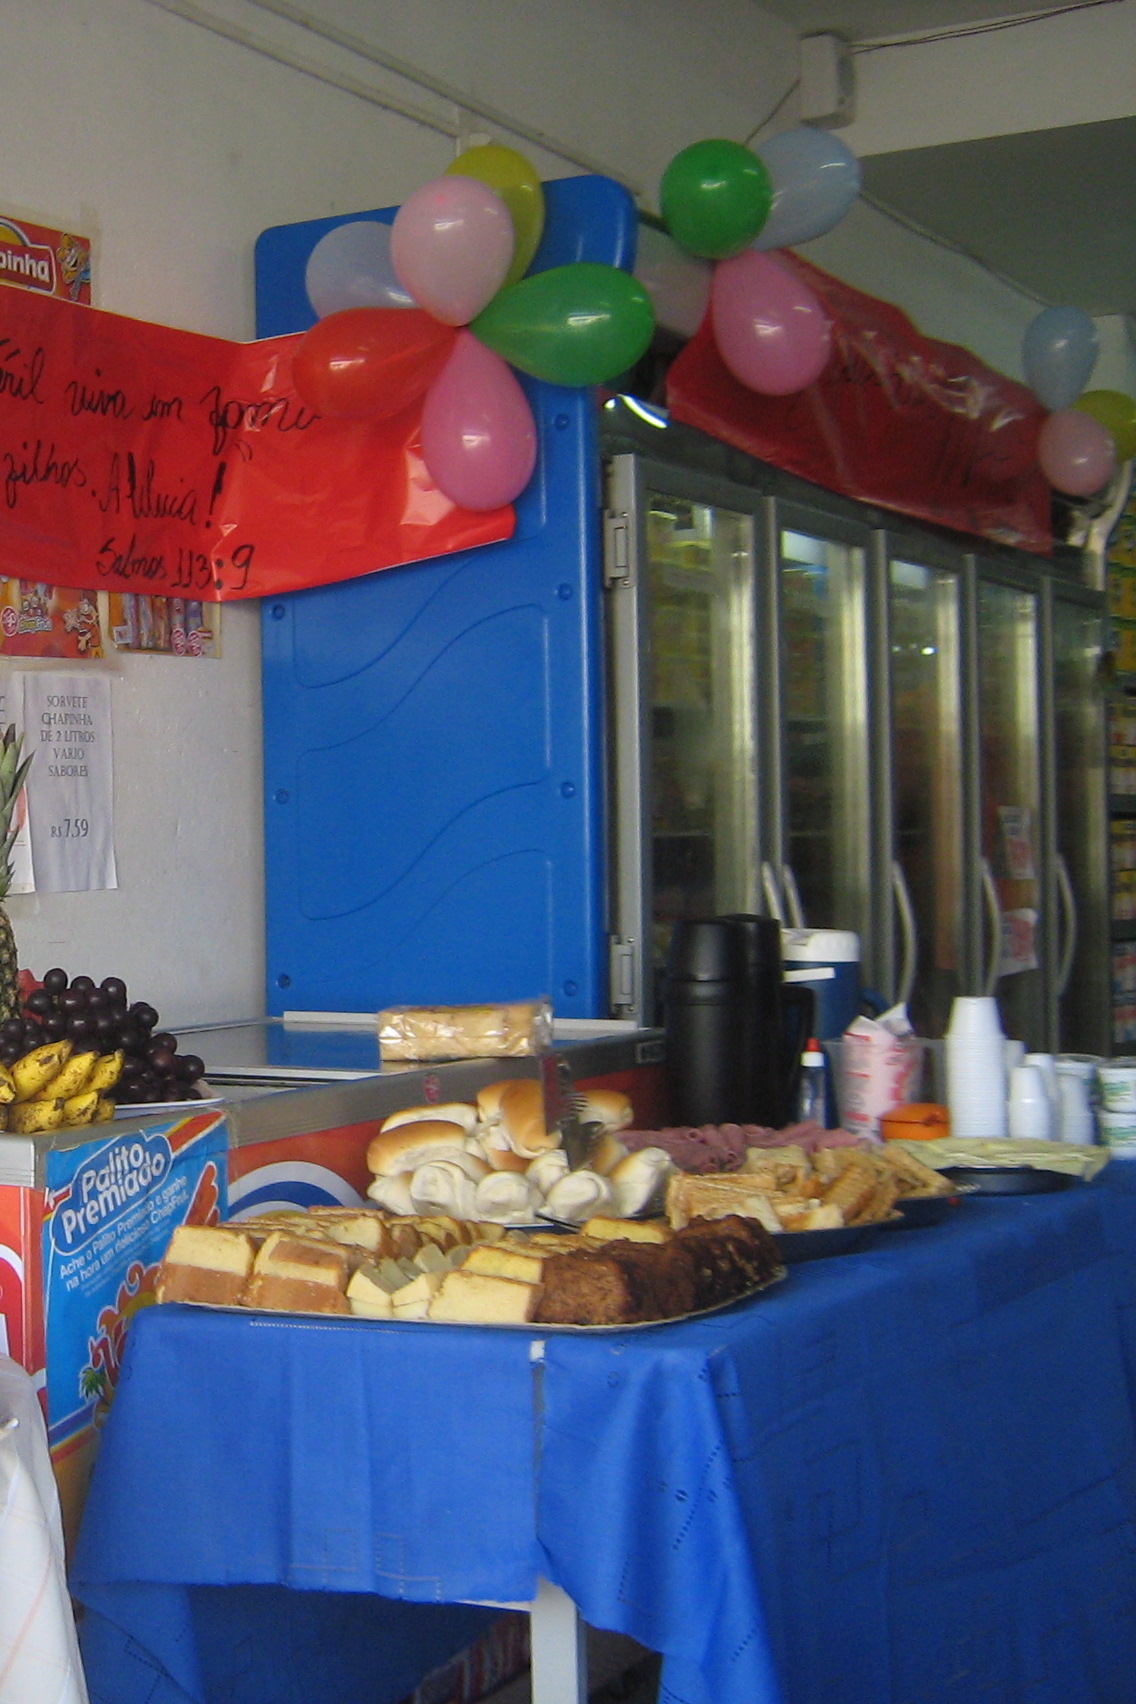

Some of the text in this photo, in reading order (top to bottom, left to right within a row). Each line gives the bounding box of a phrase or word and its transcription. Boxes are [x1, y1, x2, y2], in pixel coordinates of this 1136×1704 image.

[65, 368, 135, 421] viva
[41, 712, 93, 726] CHAPINHA
[47, 695, 88, 709] SORVETE
[40, 730, 95, 743] DE 2 LITROS
[48, 765, 89, 777] SABORES
[80, 1143, 144, 1204] Palito
[61, 1152, 165, 1244] Premiado
[59, 1254, 86, 1280] Ache
[92, 1231, 116, 1255] Palito
[117, 1200, 155, 1235] Premiado
[66, 1276, 80, 1292] na
[80, 1261, 101, 1281] hora
[101, 1250, 115, 1266] um
